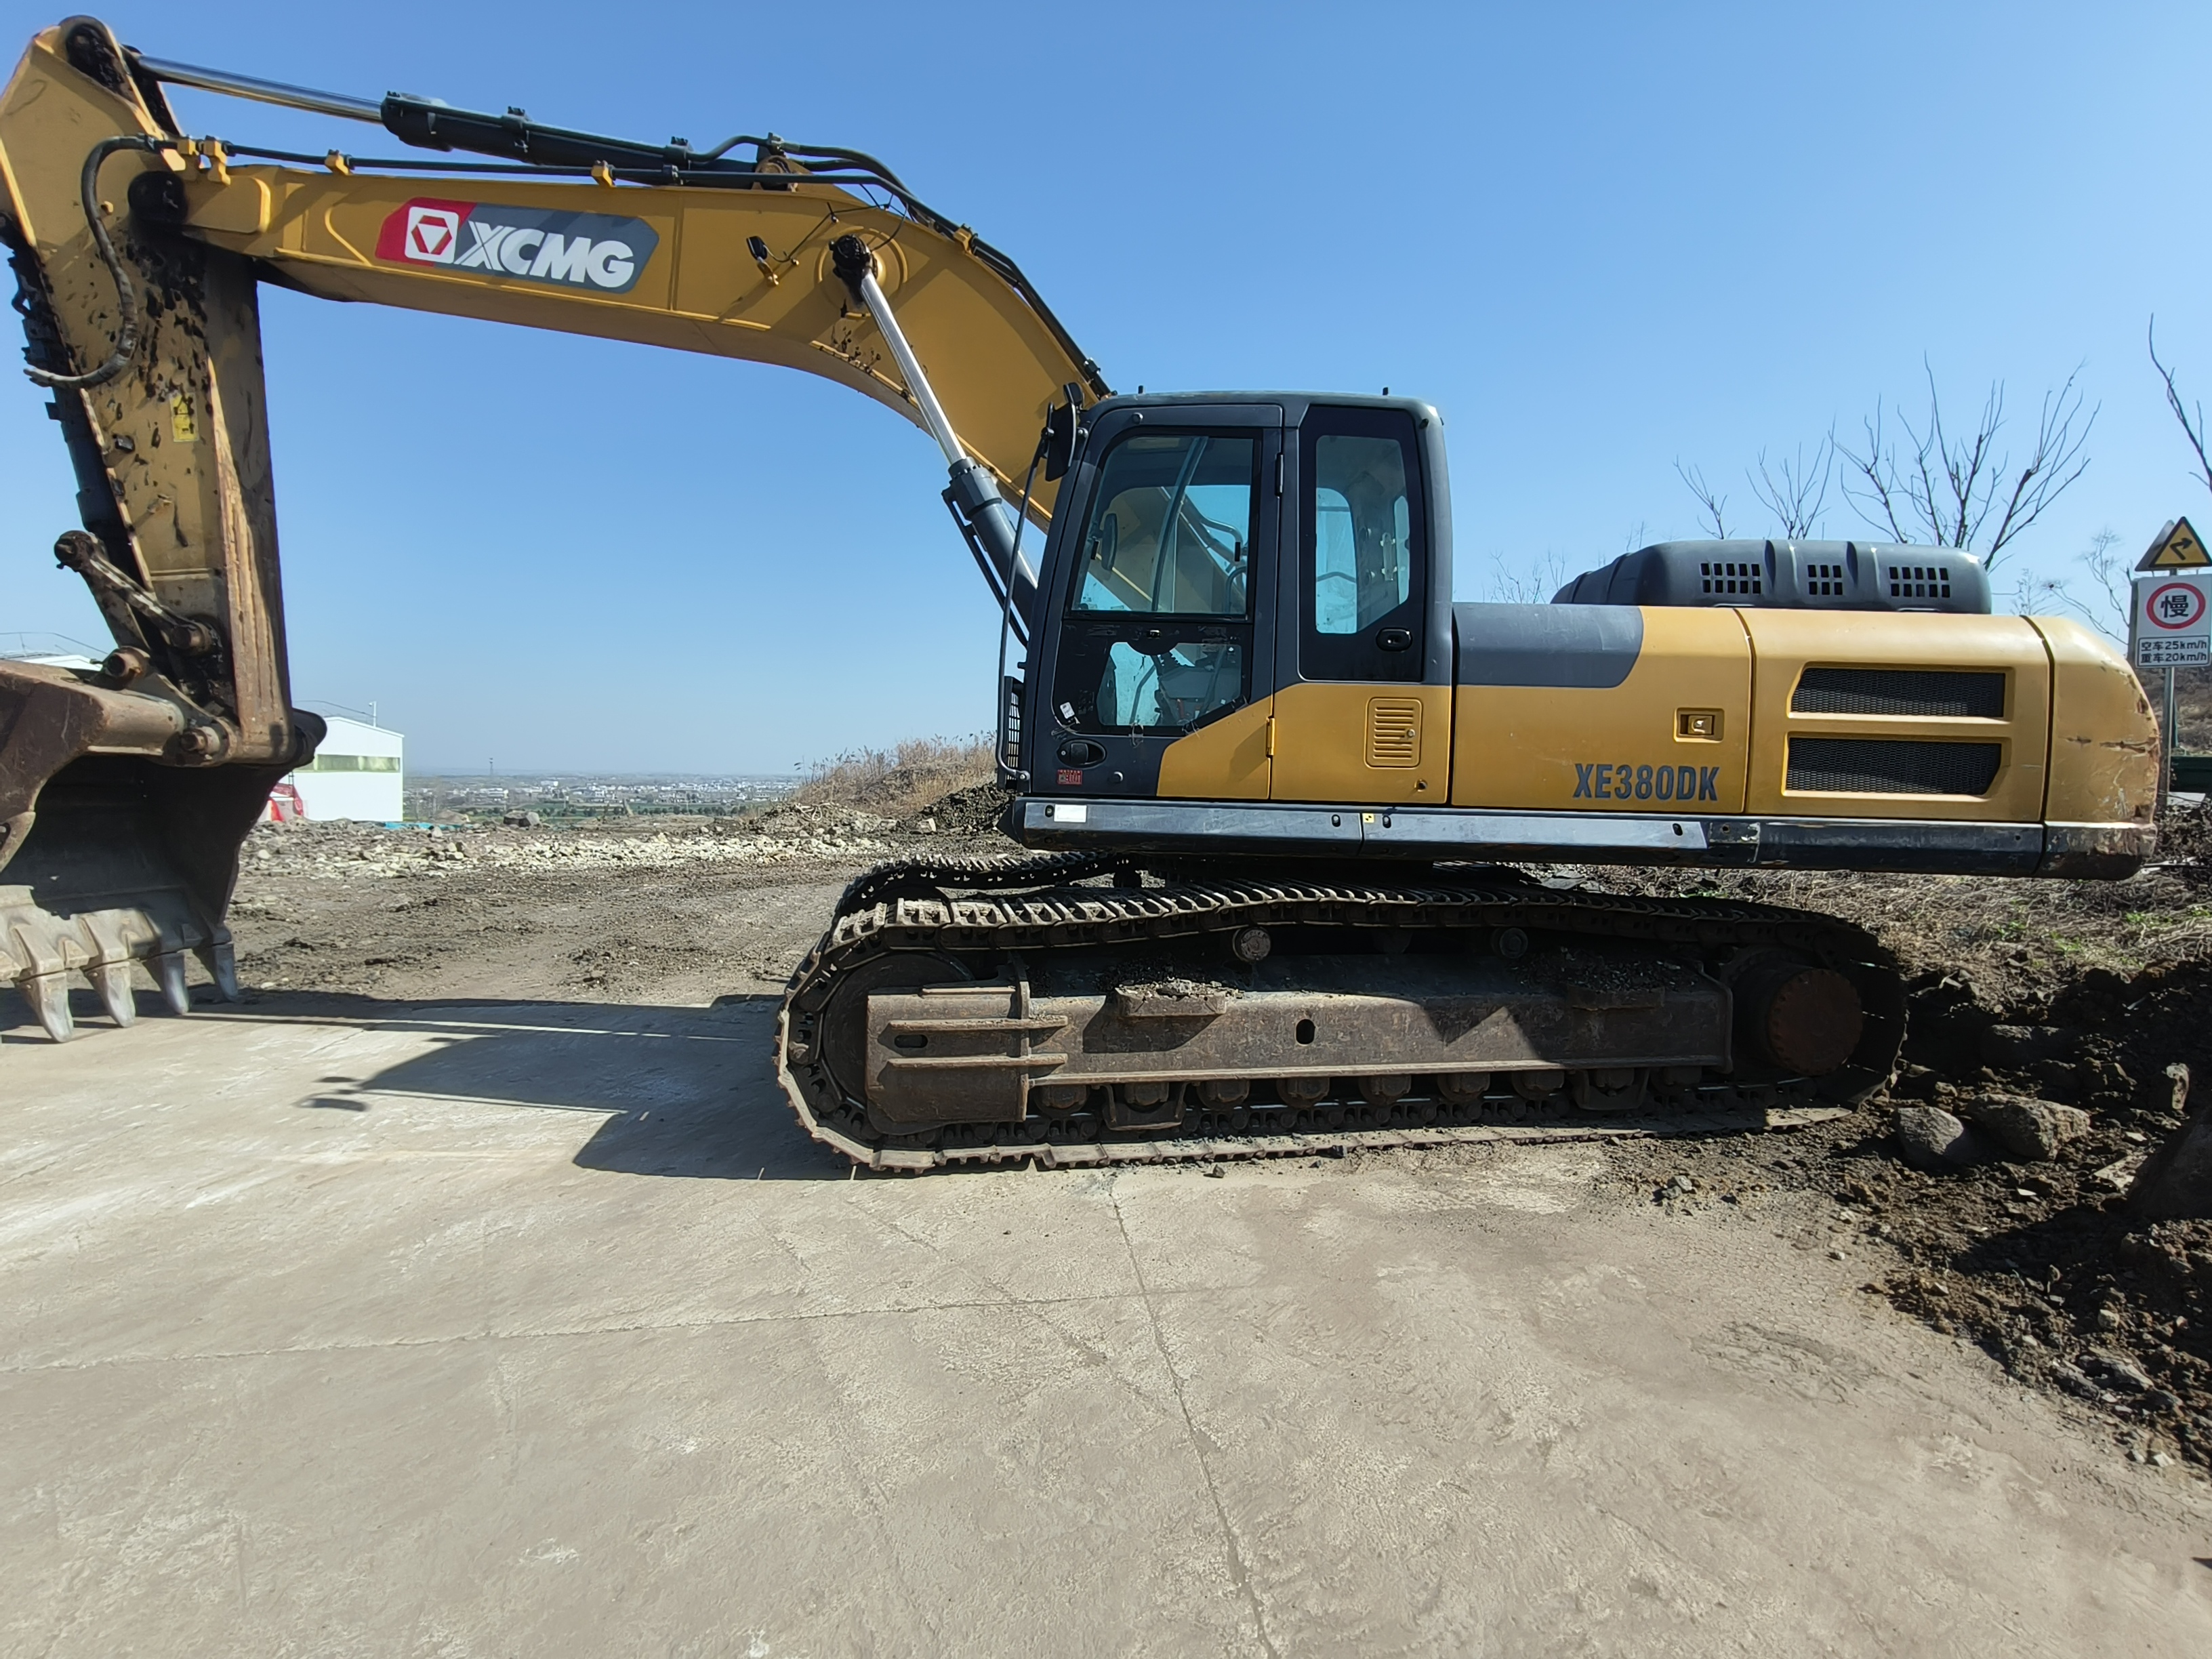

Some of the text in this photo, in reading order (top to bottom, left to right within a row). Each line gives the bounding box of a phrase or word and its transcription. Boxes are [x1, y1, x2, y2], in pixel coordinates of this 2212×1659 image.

[453, 220, 634, 288] XCMG
[2160, 594, 2189, 618] 慢
[1572, 763, 1720, 801] XE380DK
